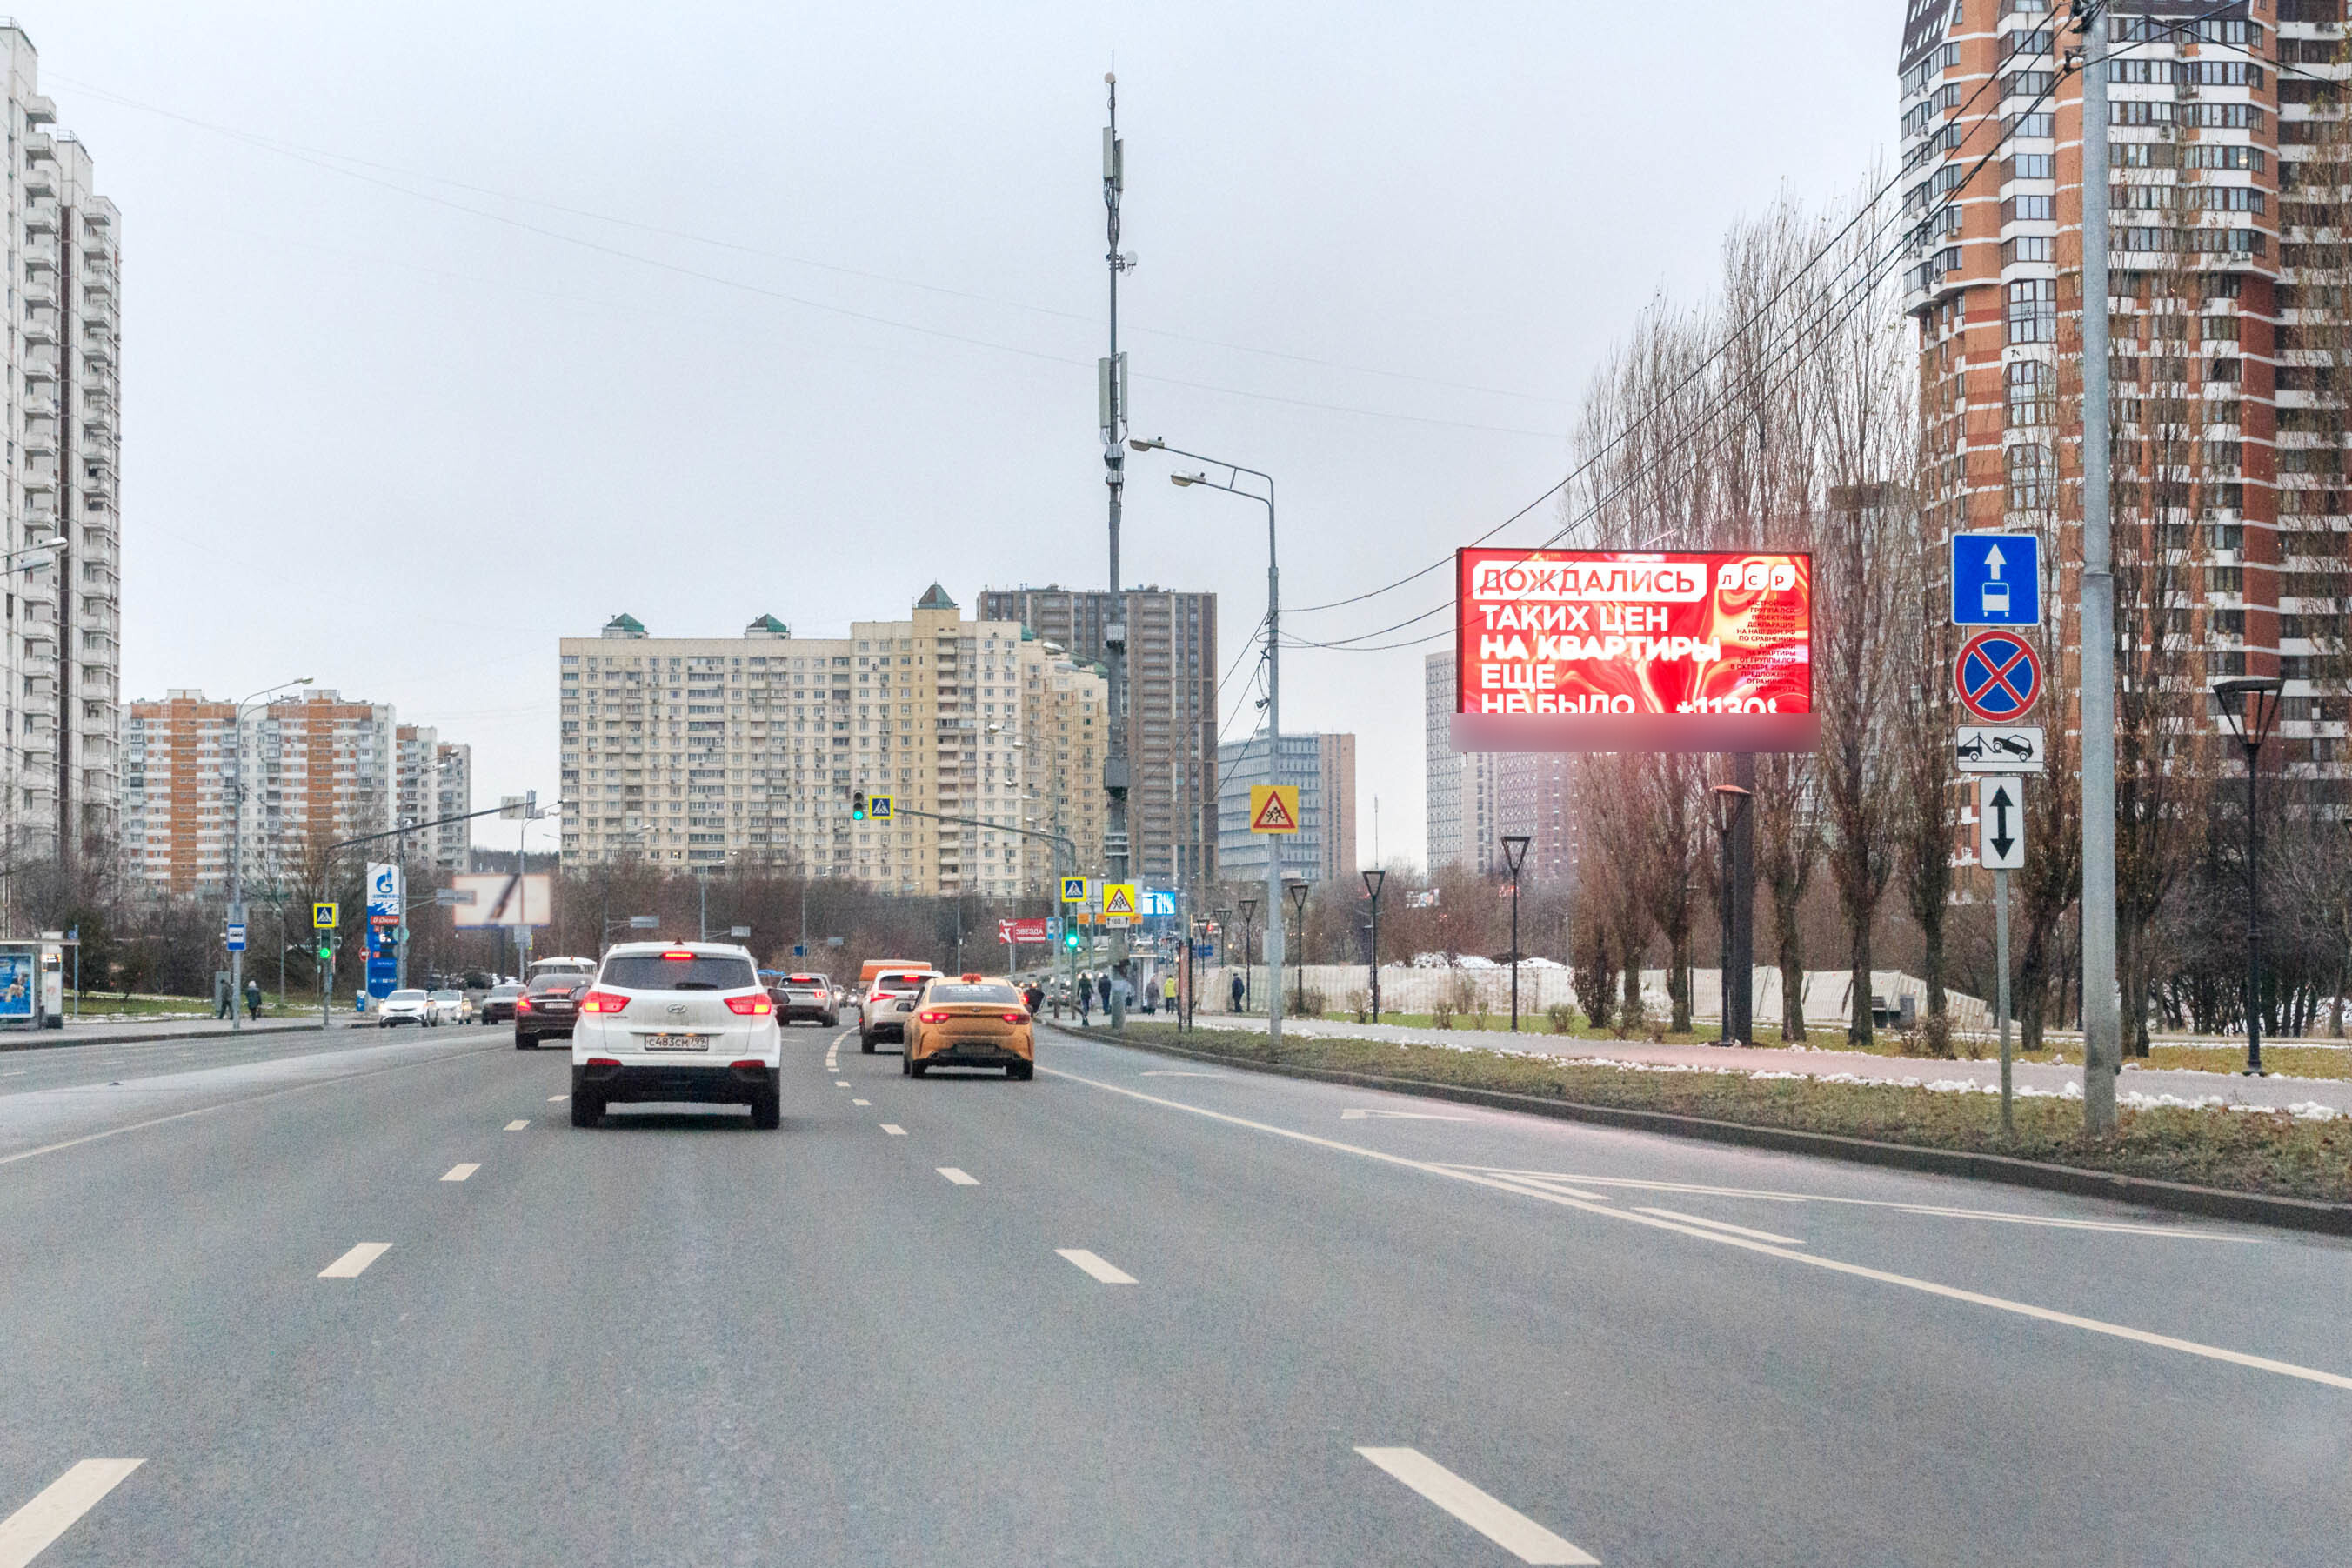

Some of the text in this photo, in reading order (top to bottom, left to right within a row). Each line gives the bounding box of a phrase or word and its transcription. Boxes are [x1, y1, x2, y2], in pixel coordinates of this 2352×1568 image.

[1480, 568, 1695, 597] ДОЖДАЛИСЬ
[1479, 604, 1669, 636] ТАКИХ ЦЕН
[1480, 634, 1721, 663] НА КВАРТИРЫ
[1480, 664, 1557, 694] ЕЩЕ
[1481, 693, 1636, 713] НЕ БЫЛО
